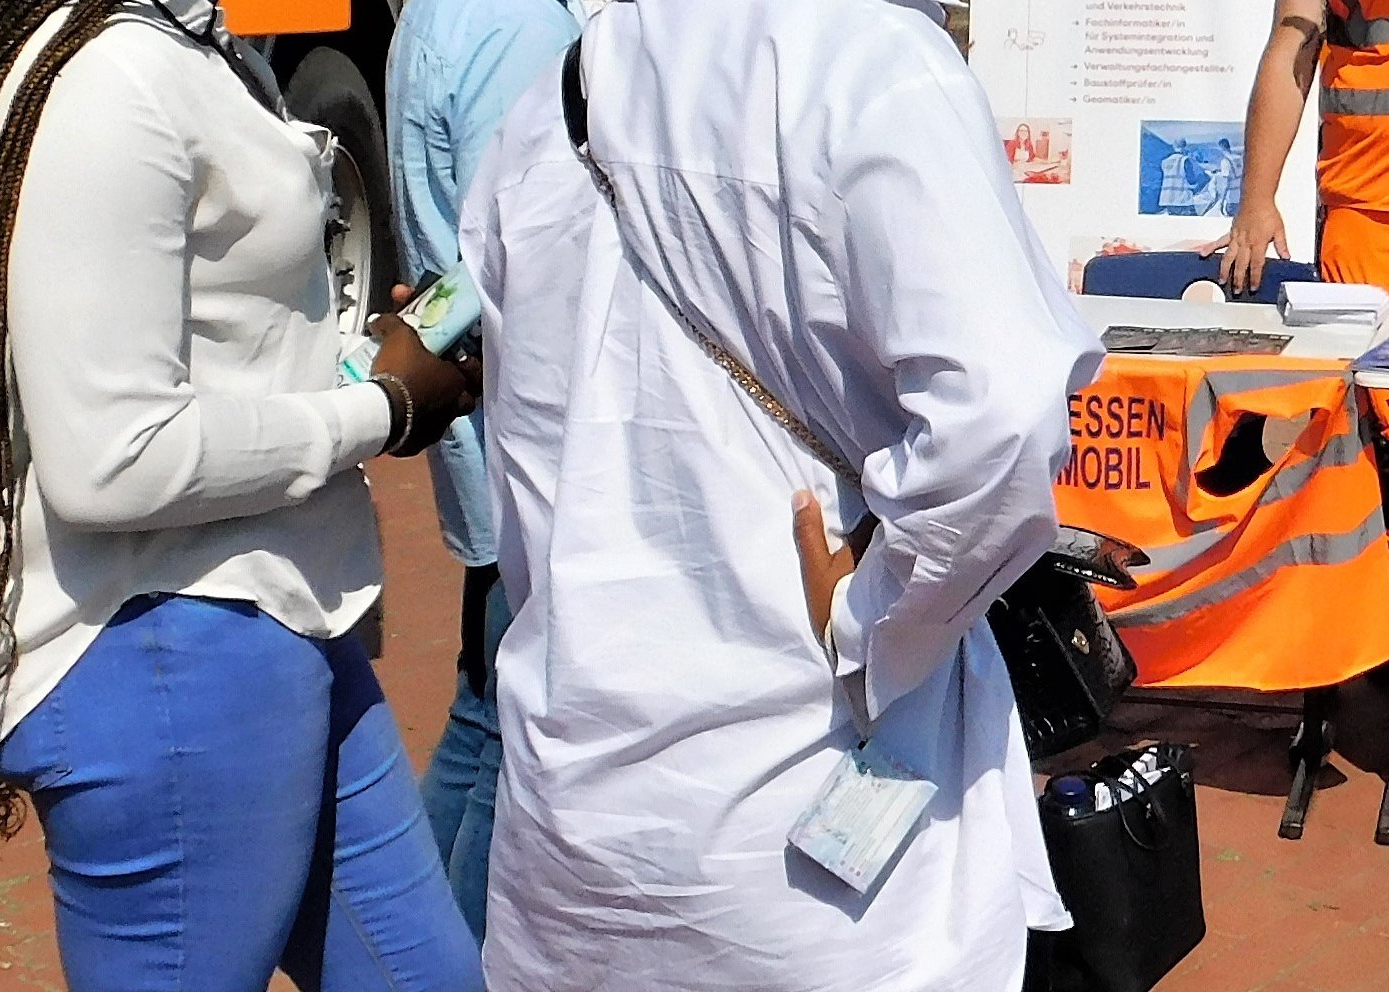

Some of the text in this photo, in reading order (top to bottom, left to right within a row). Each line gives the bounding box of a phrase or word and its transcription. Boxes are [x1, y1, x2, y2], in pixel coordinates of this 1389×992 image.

[1085, 2, 1186, 12] und Verkehrstechnik
[1085, 32, 1215, 44] für Systemintegration und
[1084, 46, 1209, 58] Anwendungsentwicklung
[1067, 394, 1166, 441] ESSEN
[1057, 444, 1151, 491] MOBIL
